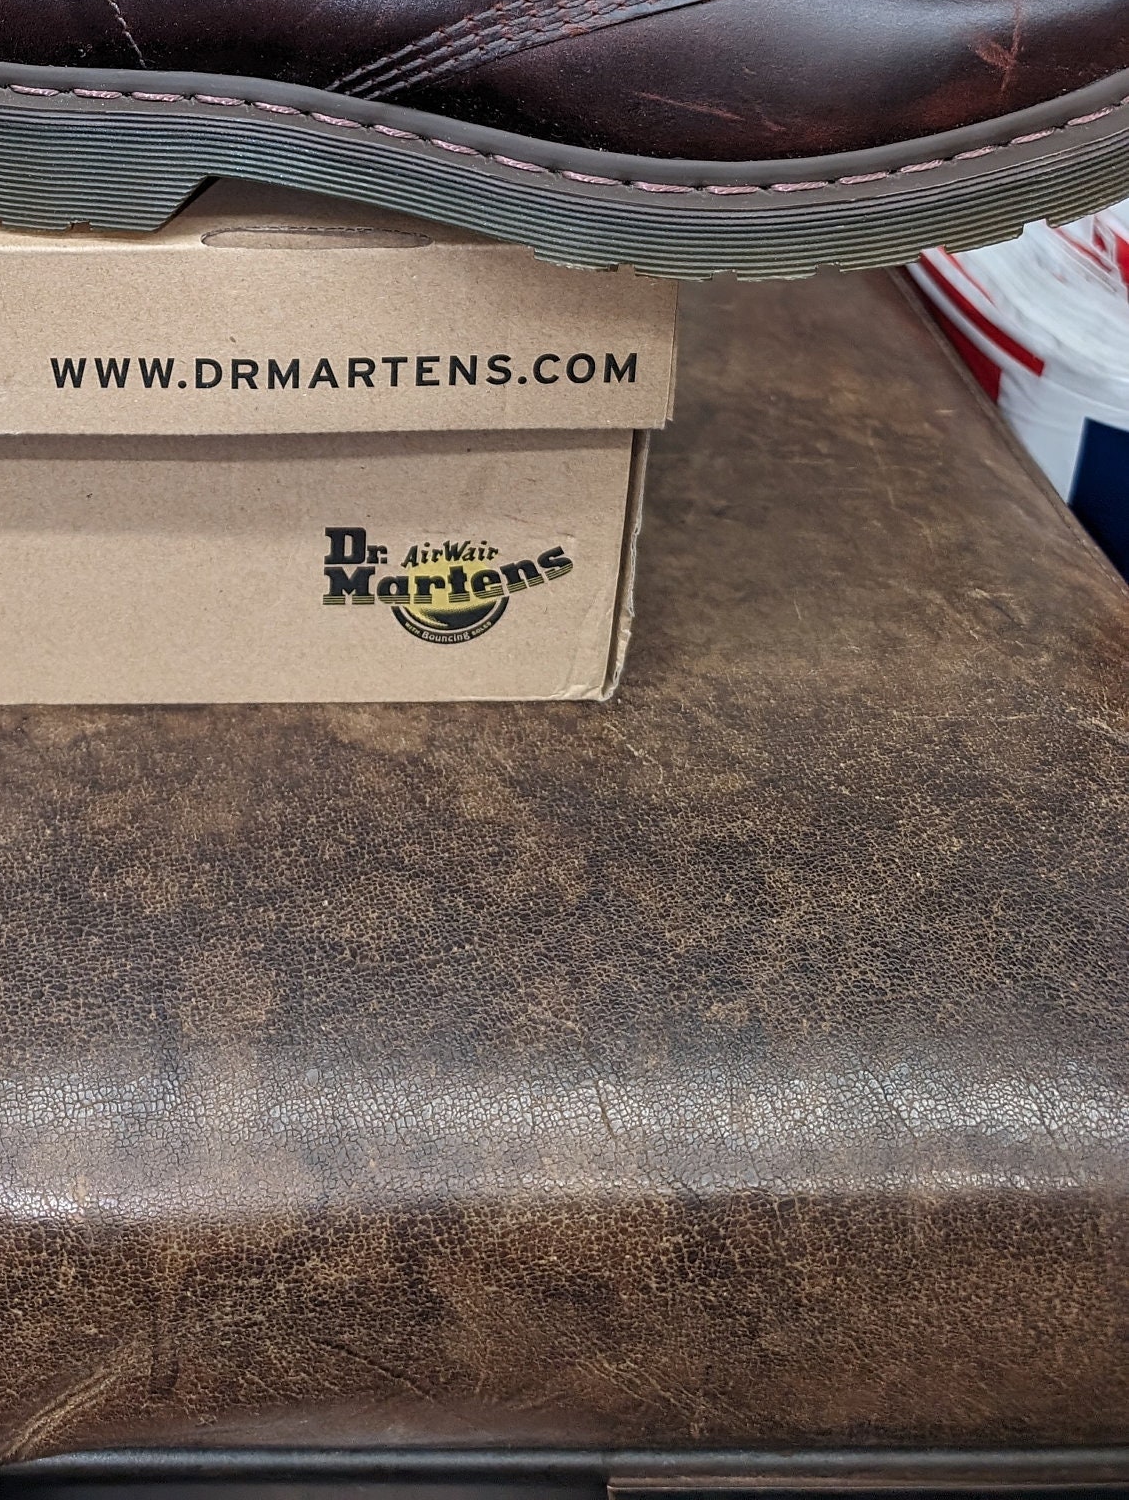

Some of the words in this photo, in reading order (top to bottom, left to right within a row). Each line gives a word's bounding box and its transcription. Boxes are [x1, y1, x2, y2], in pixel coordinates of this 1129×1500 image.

[50, 353, 638, 390] WWW.DRMARTENS.COM
[324, 526, 388, 565] Dr.
[323, 546, 573, 605] Martens
[422, 630, 470, 643] Bouncing
